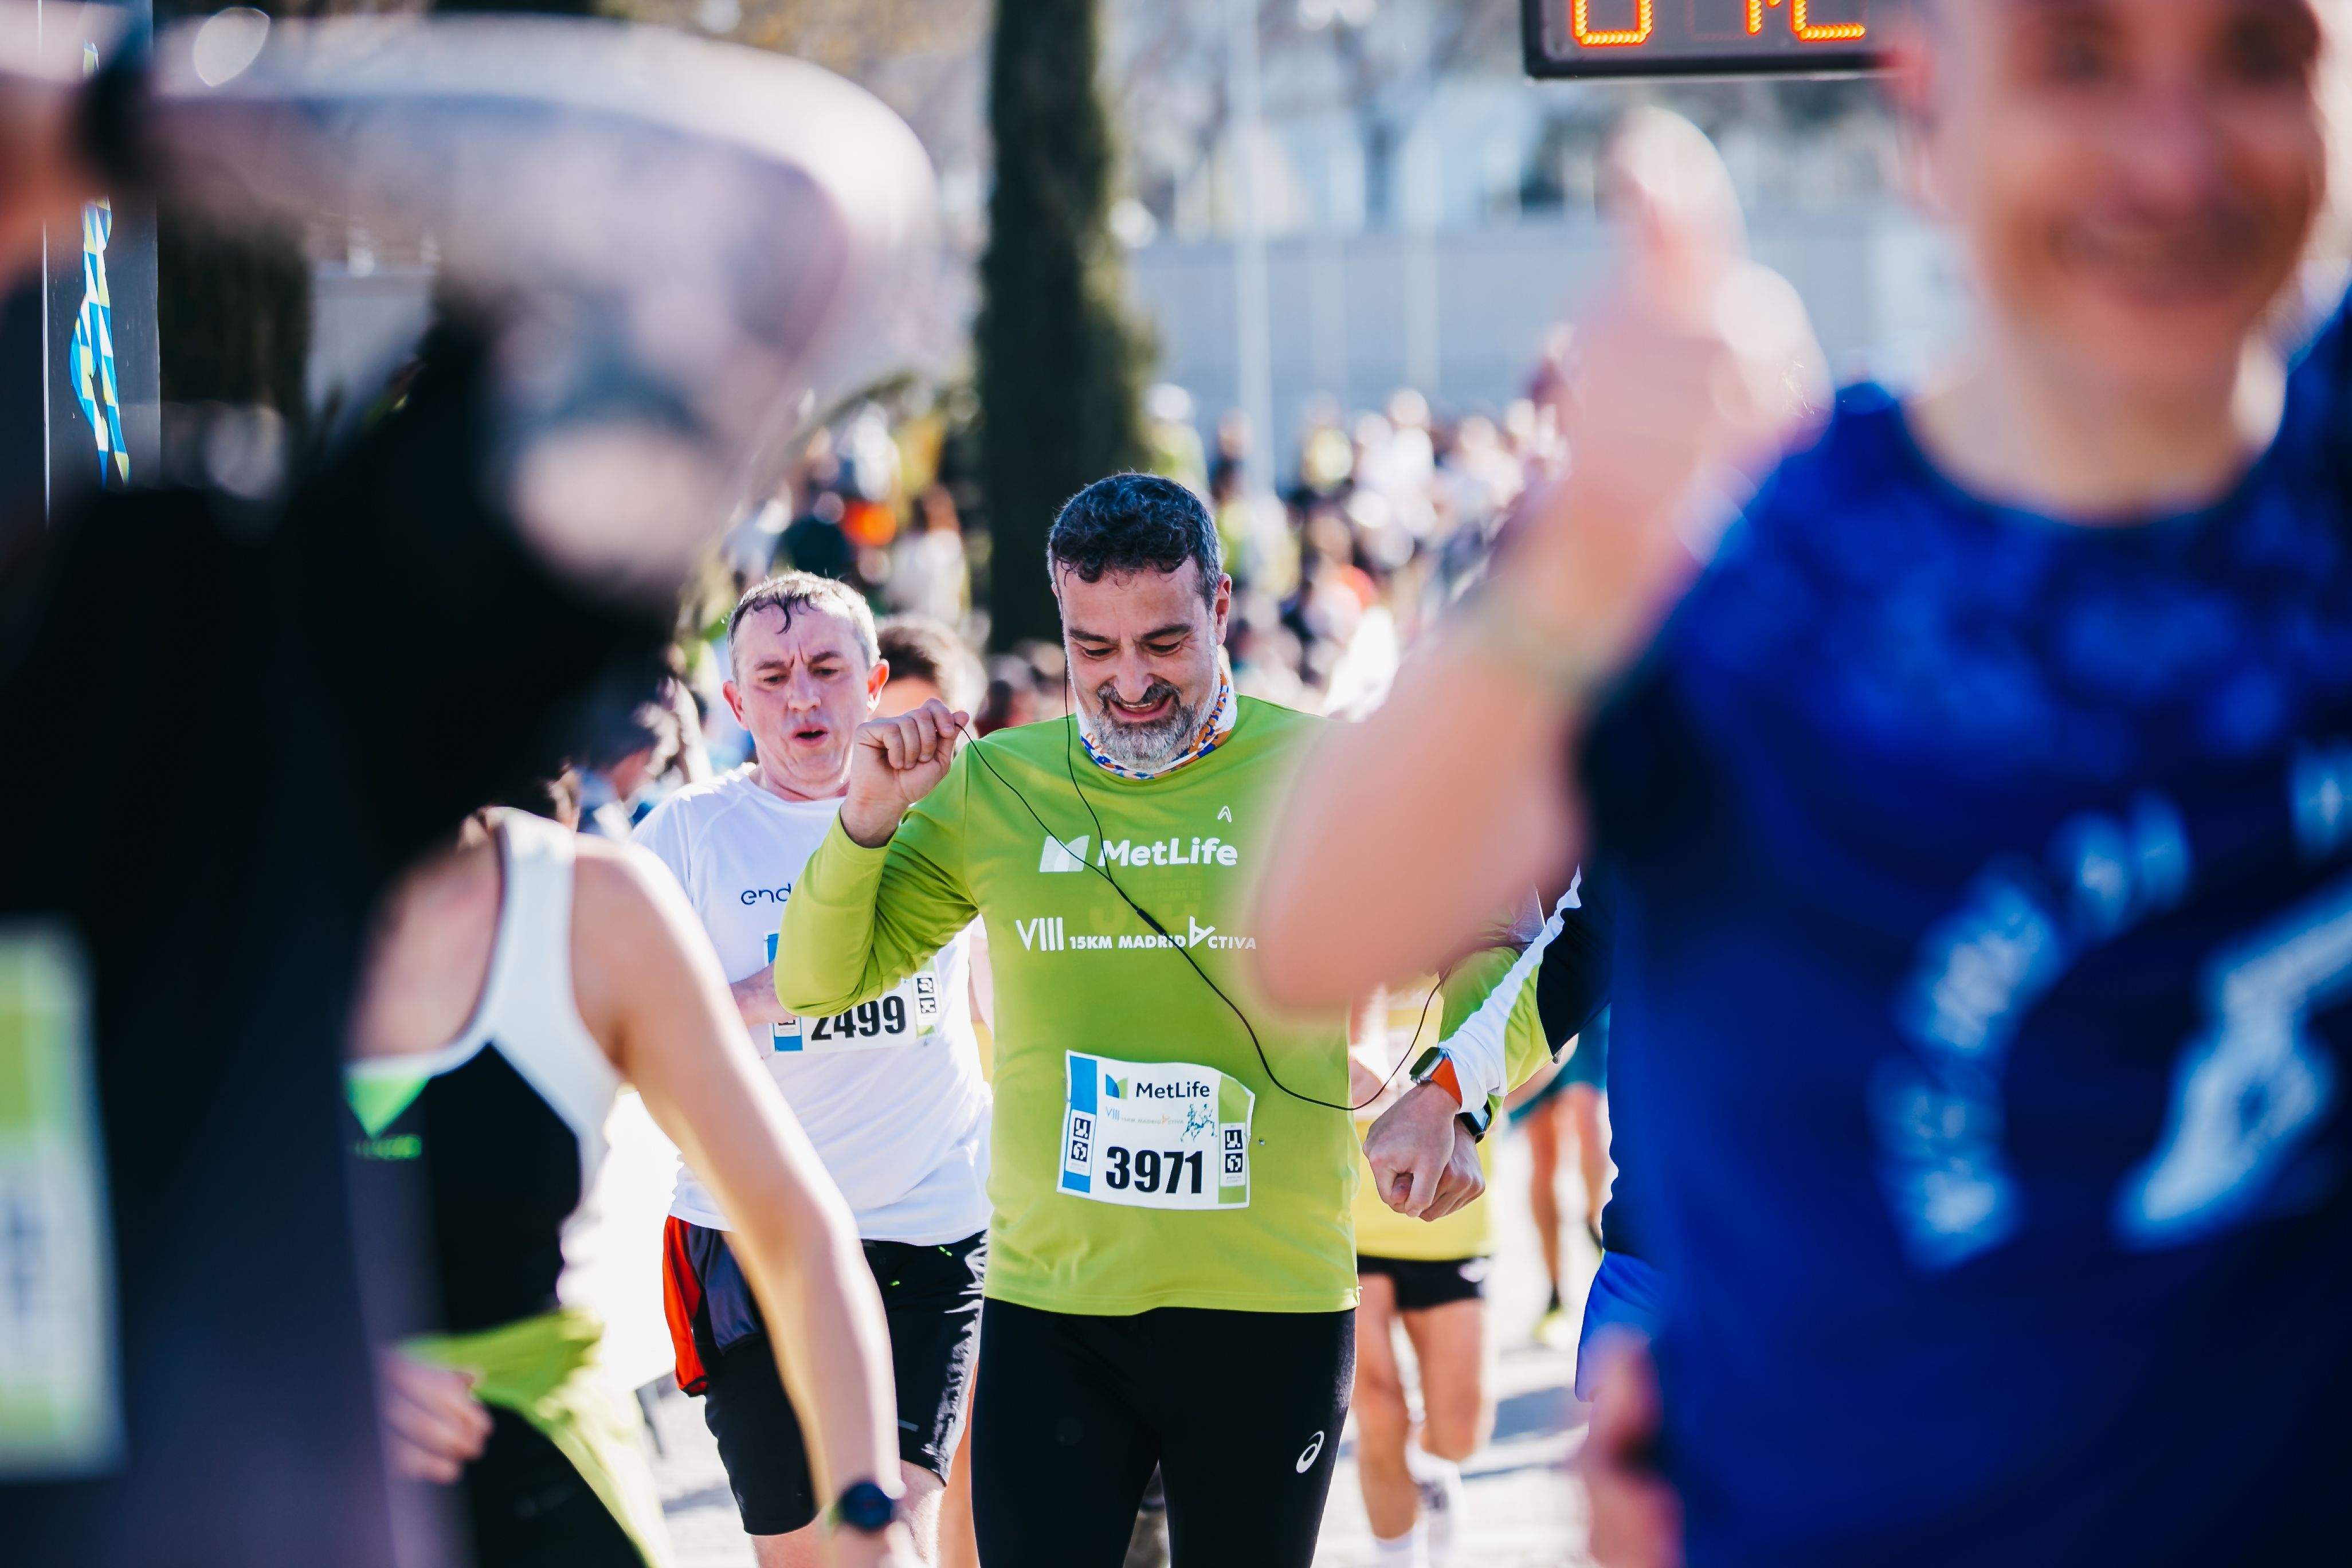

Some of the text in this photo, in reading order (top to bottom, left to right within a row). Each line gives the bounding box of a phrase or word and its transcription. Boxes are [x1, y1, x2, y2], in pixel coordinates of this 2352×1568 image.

[1098, 837, 1238, 867] MetLife
[1016, 917, 1065, 951] VIII
[1069, 935, 1113, 950] 15KM
[1118, 935, 1186, 948] MADRID
[1136, 1081, 1210, 1099] MetLife
[1106, 1146, 1203, 1194] 3971
